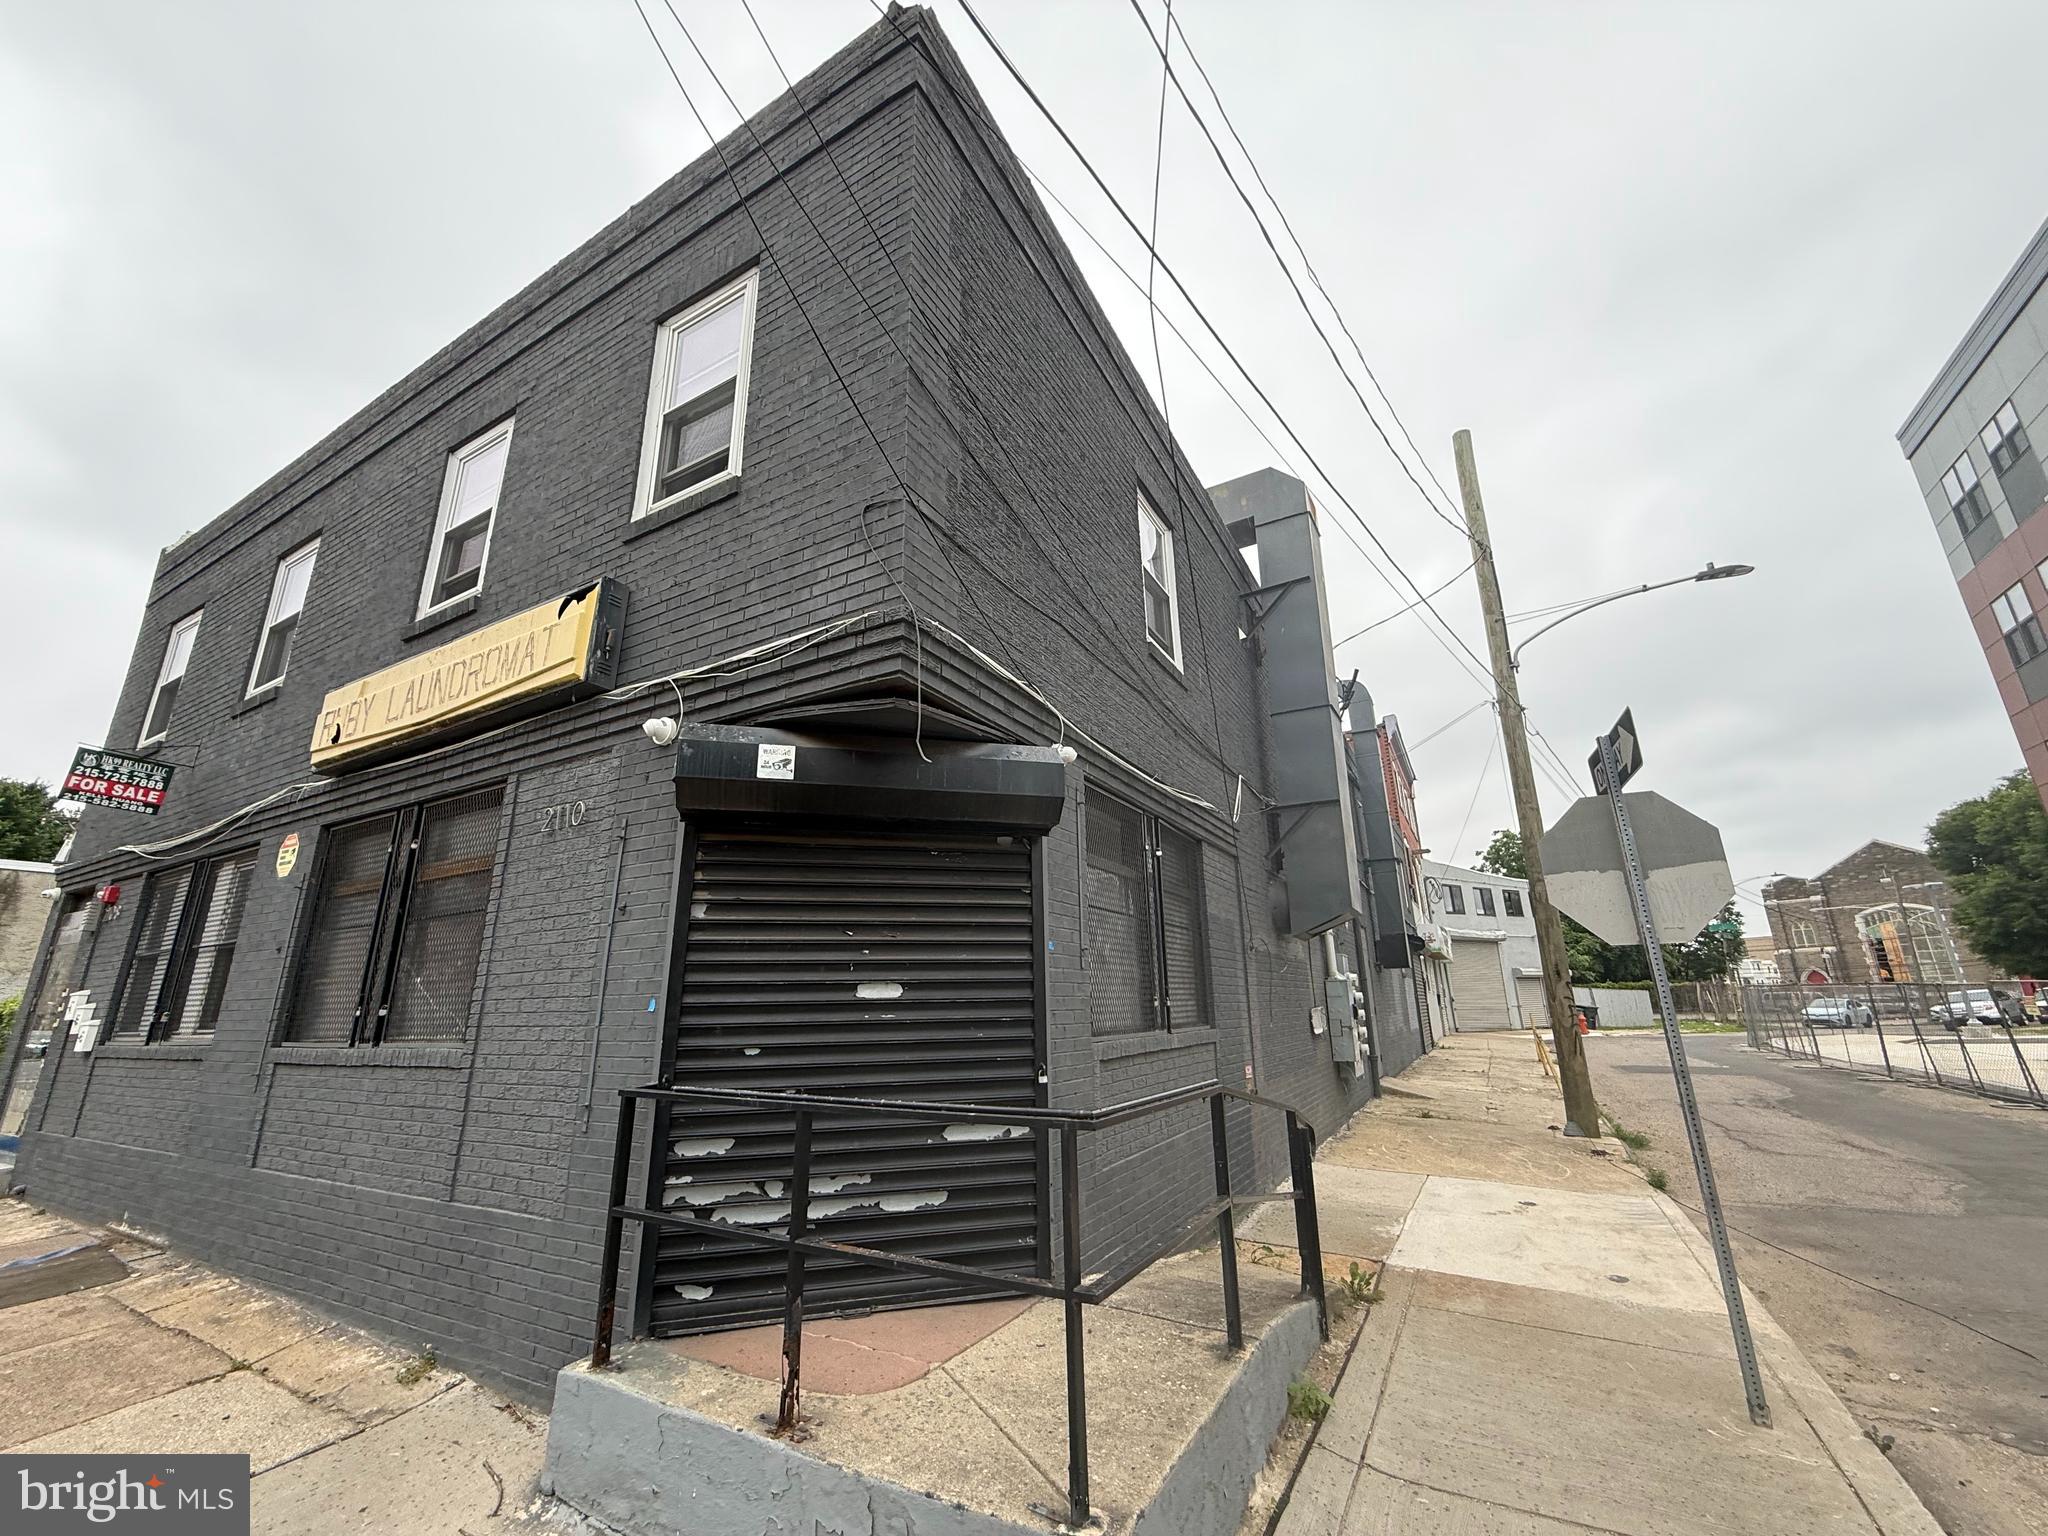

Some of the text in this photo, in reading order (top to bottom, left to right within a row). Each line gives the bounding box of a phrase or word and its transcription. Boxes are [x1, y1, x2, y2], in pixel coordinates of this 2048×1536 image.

[384, 622, 561, 725] LAUNDROMAT
[73, 765, 164, 790] 215-725-7888
[122, 759, 152, 772] REALTY
[152, 766, 169, 776] LLC
[68, 775, 161, 803] FOR SALE
[62, 792, 154, 814] 215-582-5888
[541, 801, 585, 831] 2110
